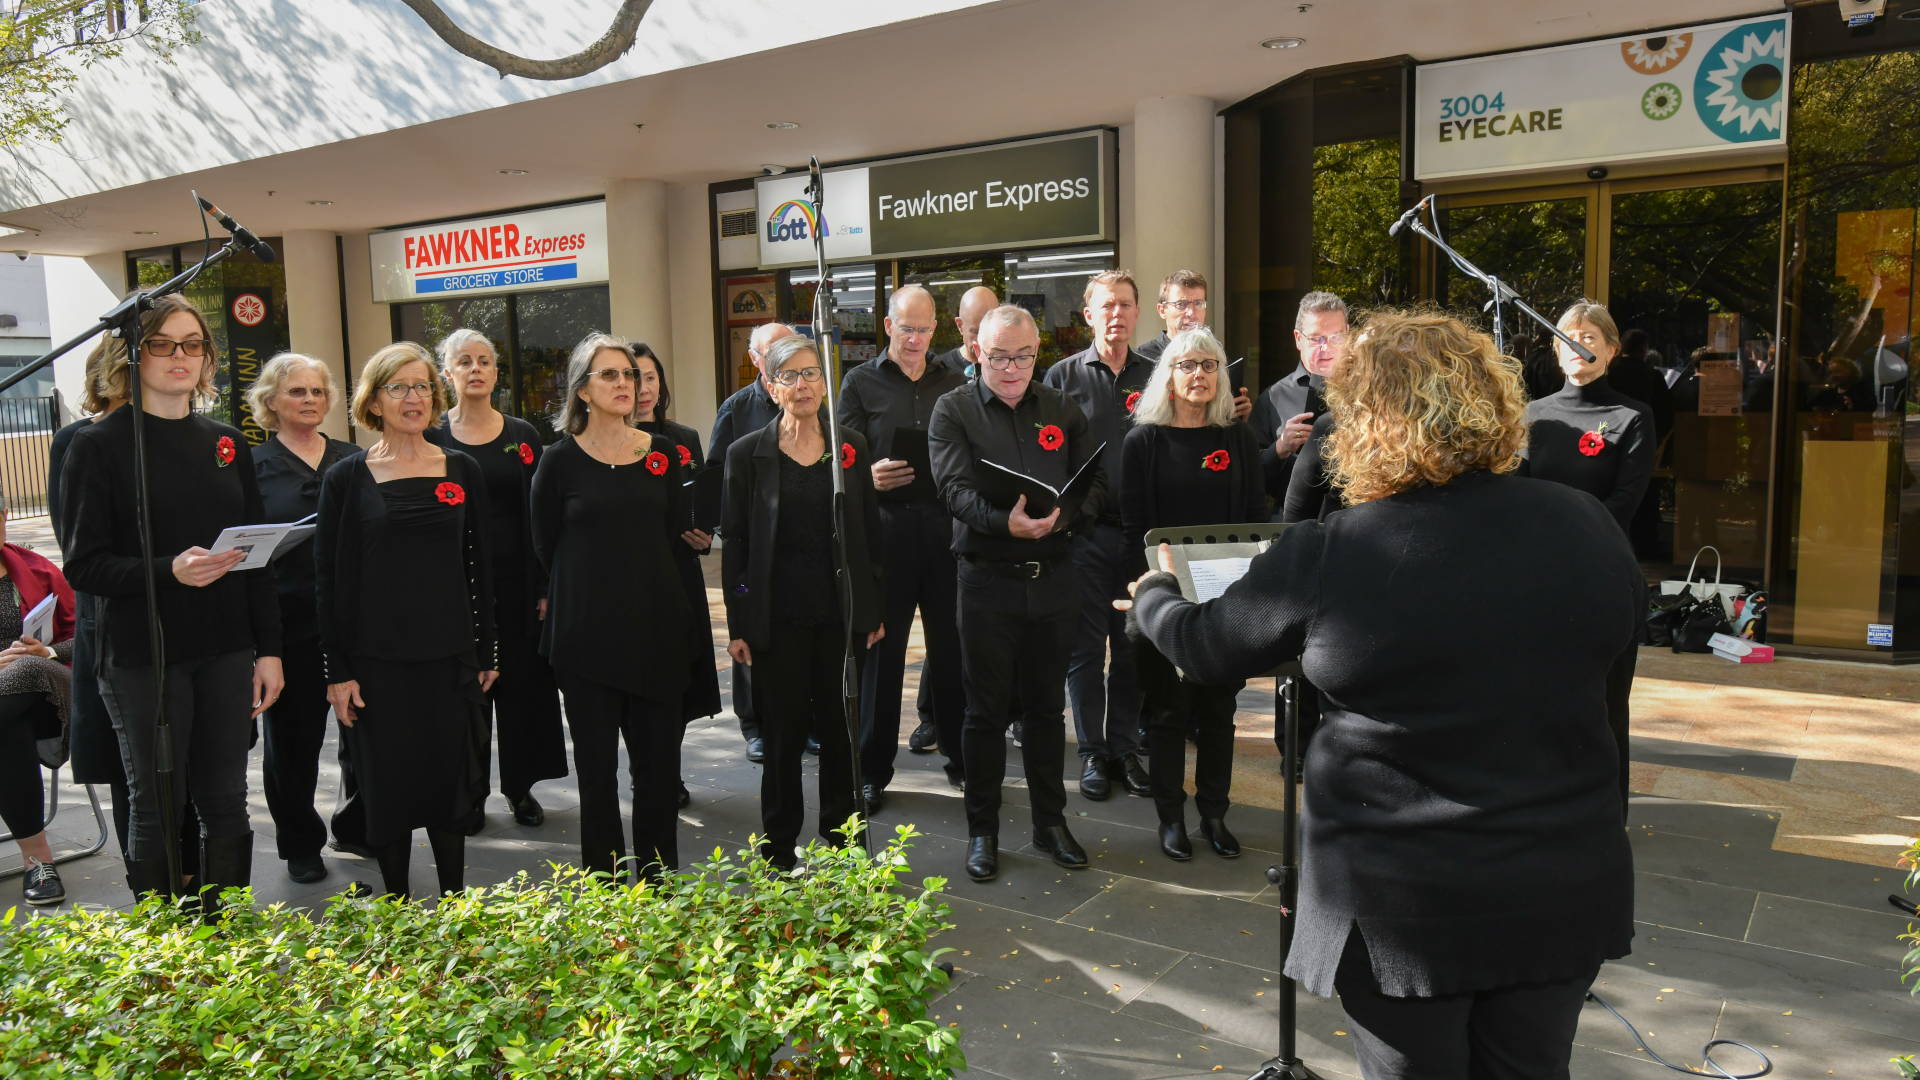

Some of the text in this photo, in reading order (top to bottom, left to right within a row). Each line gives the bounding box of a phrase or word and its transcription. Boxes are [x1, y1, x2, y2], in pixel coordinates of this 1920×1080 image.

[1440, 91, 1505, 119] 3004
[1439, 108, 1563, 142] EYECARE
[878, 177, 1090, 221] Fawkner Express
[404, 223, 586, 269] FAWKNER Express
[767, 218, 807, 242] Lott
[443, 267, 544, 290] GROCERY STORE
[235, 347, 258, 382] INN
